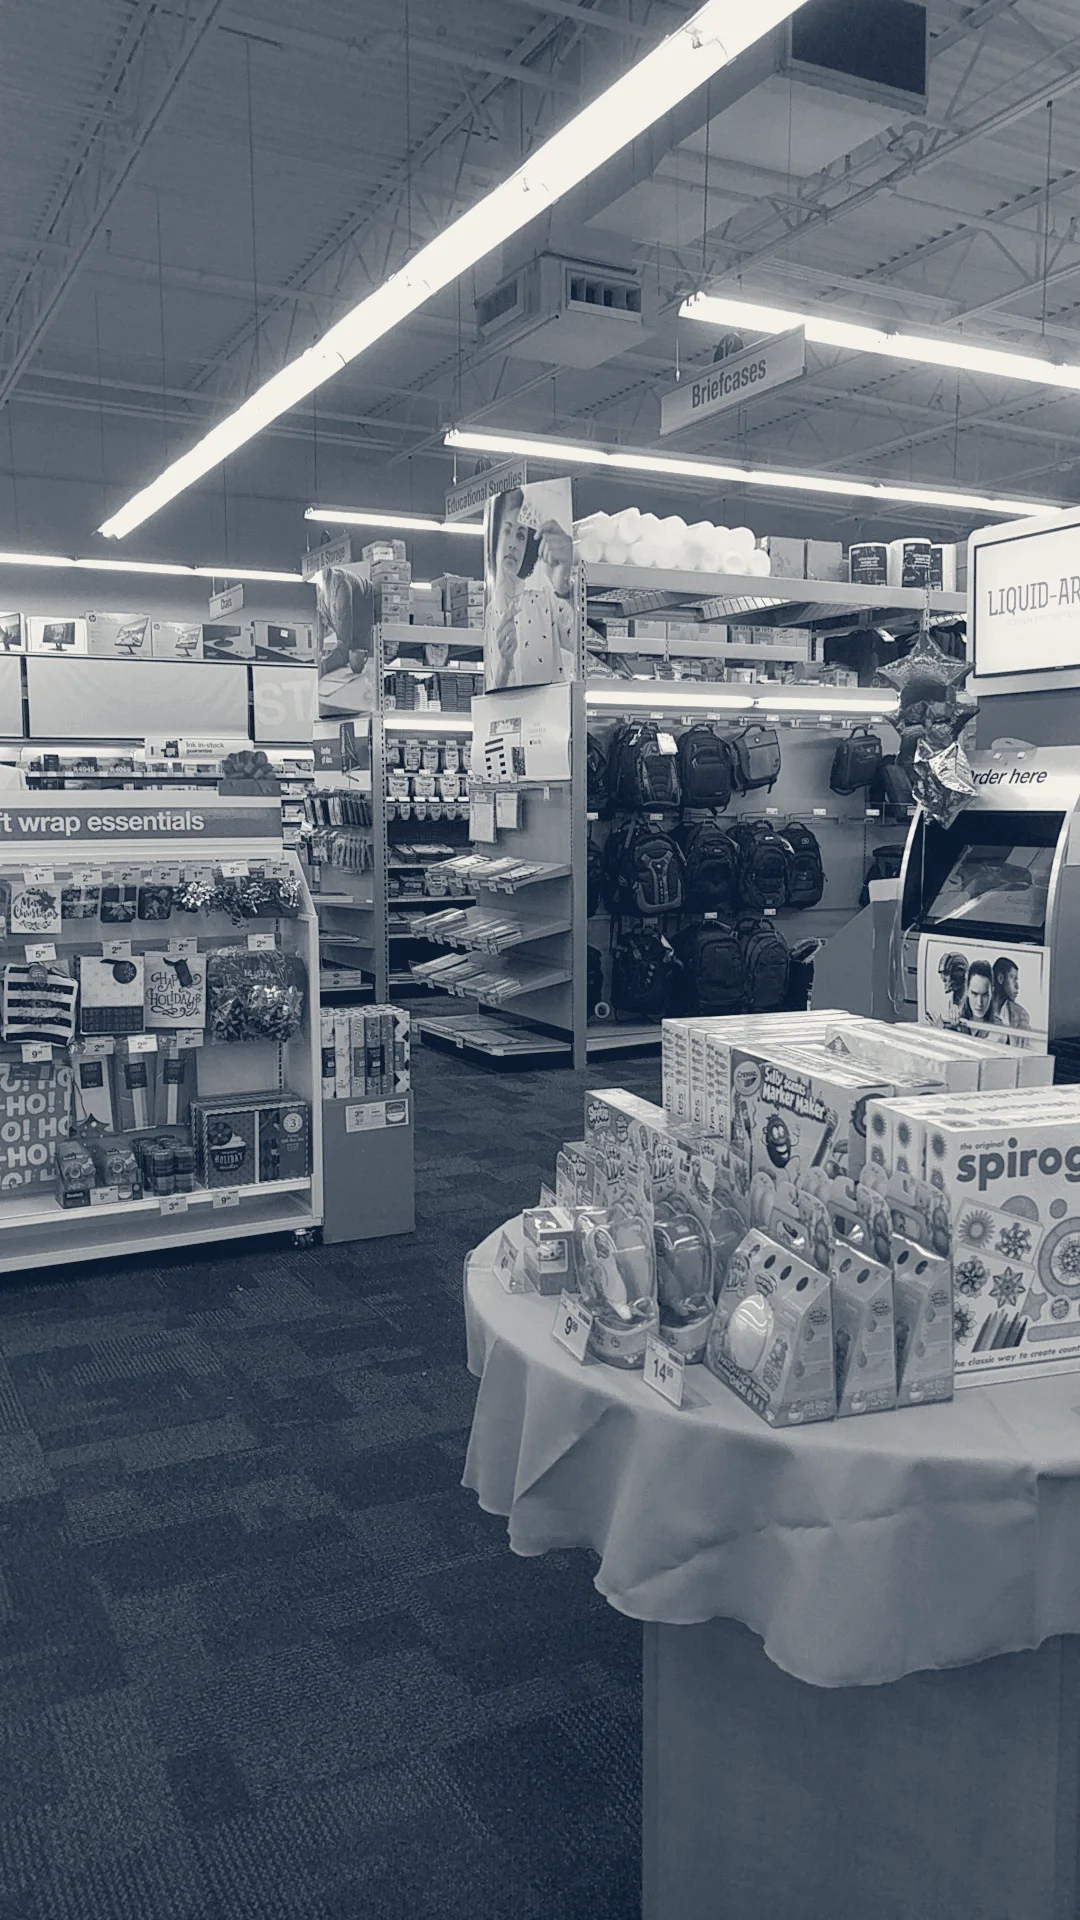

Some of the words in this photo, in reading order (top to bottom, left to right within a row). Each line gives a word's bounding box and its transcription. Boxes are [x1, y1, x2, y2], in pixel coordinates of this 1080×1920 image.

[691, 358, 767, 409] Briefcases
[446, 484, 488, 515] Educational
[488, 471, 523, 497] Supplies
[988, 575, 1080, 617] LIQUID-AR
[198, 741, 225, 749] in-stock
[1008, 768, 1048, 784] here
[18, 815, 81, 837] wrap
[87, 810, 206, 832] essentials
[764, 1066, 784, 1086] Silly
[762, 1083, 795, 1108] Marker
[795, 1095, 825, 1119] Maker
[975, 1140, 1005, 1150] original
[956, 1137, 1080, 1191] spirog
[968, 1355, 995, 1366] classic
[998, 1353, 1017, 1362] way
[1019, 1350, 1028, 1359] to
[1030, 1349, 1056, 1357] create
